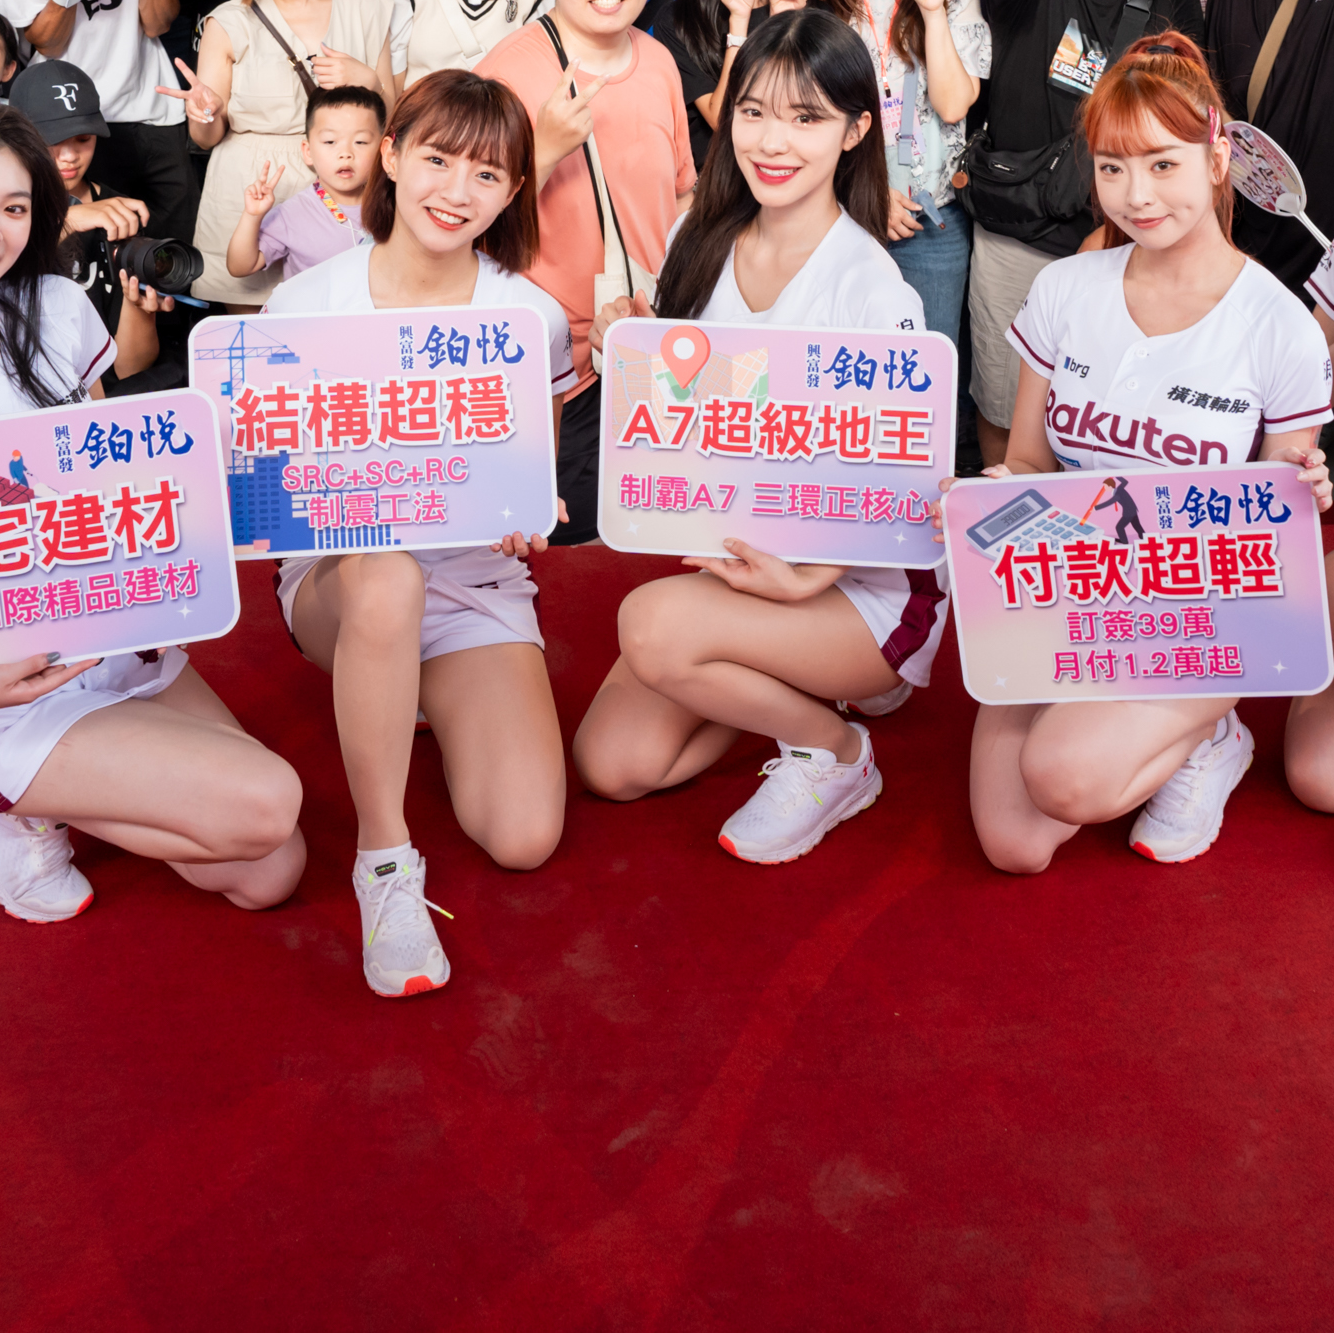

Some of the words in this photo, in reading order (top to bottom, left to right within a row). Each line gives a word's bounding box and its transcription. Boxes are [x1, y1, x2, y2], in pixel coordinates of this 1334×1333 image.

[52, 82, 79, 112] RF
[399, 325, 414, 370] 興富發
[805, 343, 821, 388] 興富發
[1070, 356, 1090, 379] brg
[233, 372, 514, 454] 結構超穩
[1167, 384, 1251, 416] 橫濱輪胎
[53, 424, 74, 474] 興富發
[620, 398, 935, 463] A7超級地王
[1046, 388, 1229, 466] Rakuten
[283, 455, 468, 492] SRC+SC+RC
[308, 488, 447, 530] 制震工法
[620, 473, 737, 511] 制霸A7
[751, 481, 931, 524] 三環正核心
[1155, 485, 1173, 530] 興富發
[993, 532, 1281, 605] 付款超輕
[1065, 605, 1215, 643] 訂簽39萬
[1052, 644, 1244, 683] 月付1.2萬起
